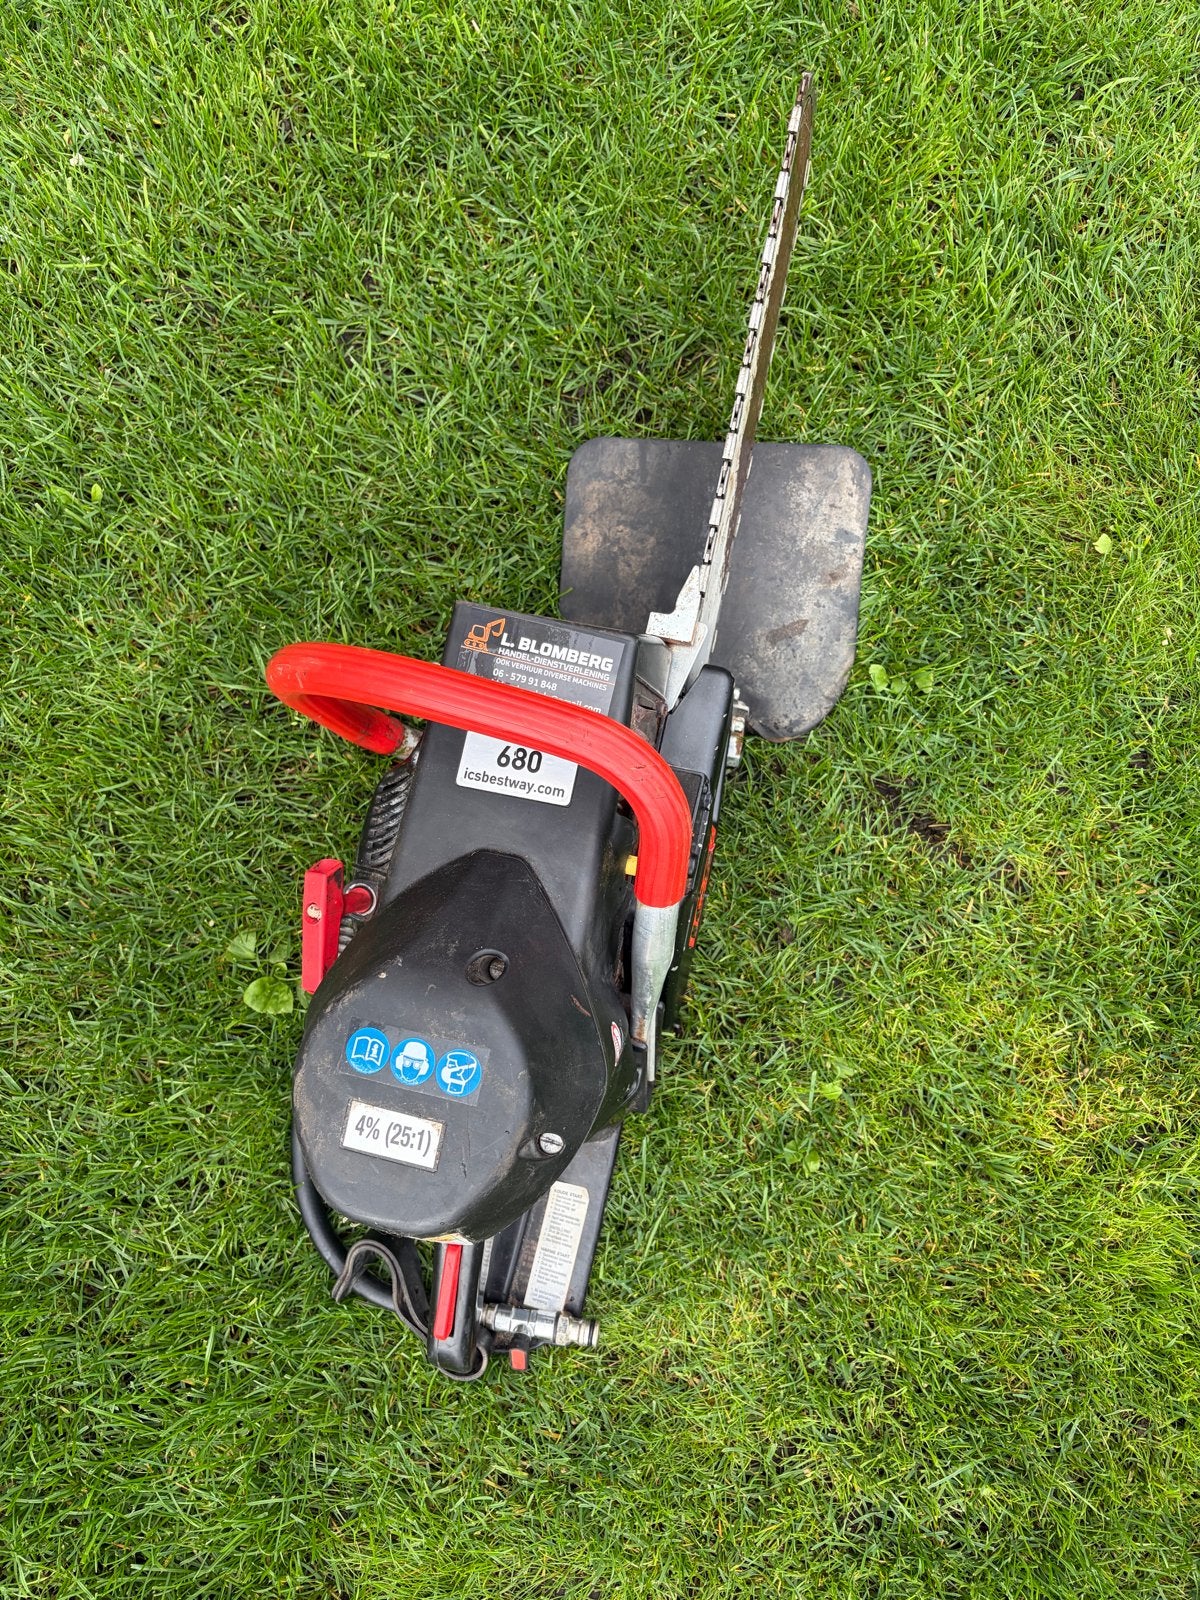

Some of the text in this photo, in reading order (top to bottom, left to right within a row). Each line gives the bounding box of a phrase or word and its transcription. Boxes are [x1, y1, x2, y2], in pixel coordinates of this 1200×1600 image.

[498, 647, 610, 682] HANDEL-DIENSTVERLENING
[500, 632, 614, 673] L. BLOMBERG
[492, 668, 504, 678] 06
[510, 672, 527, 684] 579
[528, 677, 539, 687] 91
[540, 680, 557, 691] 848
[496, 657, 608, 691] OOK VERHUUR DIVERSE MACHINES
[496, 745, 543, 774] 680
[463, 768, 565, 798] icsbestway.com
[355, 1114, 432, 1157] 4% (25:1)
